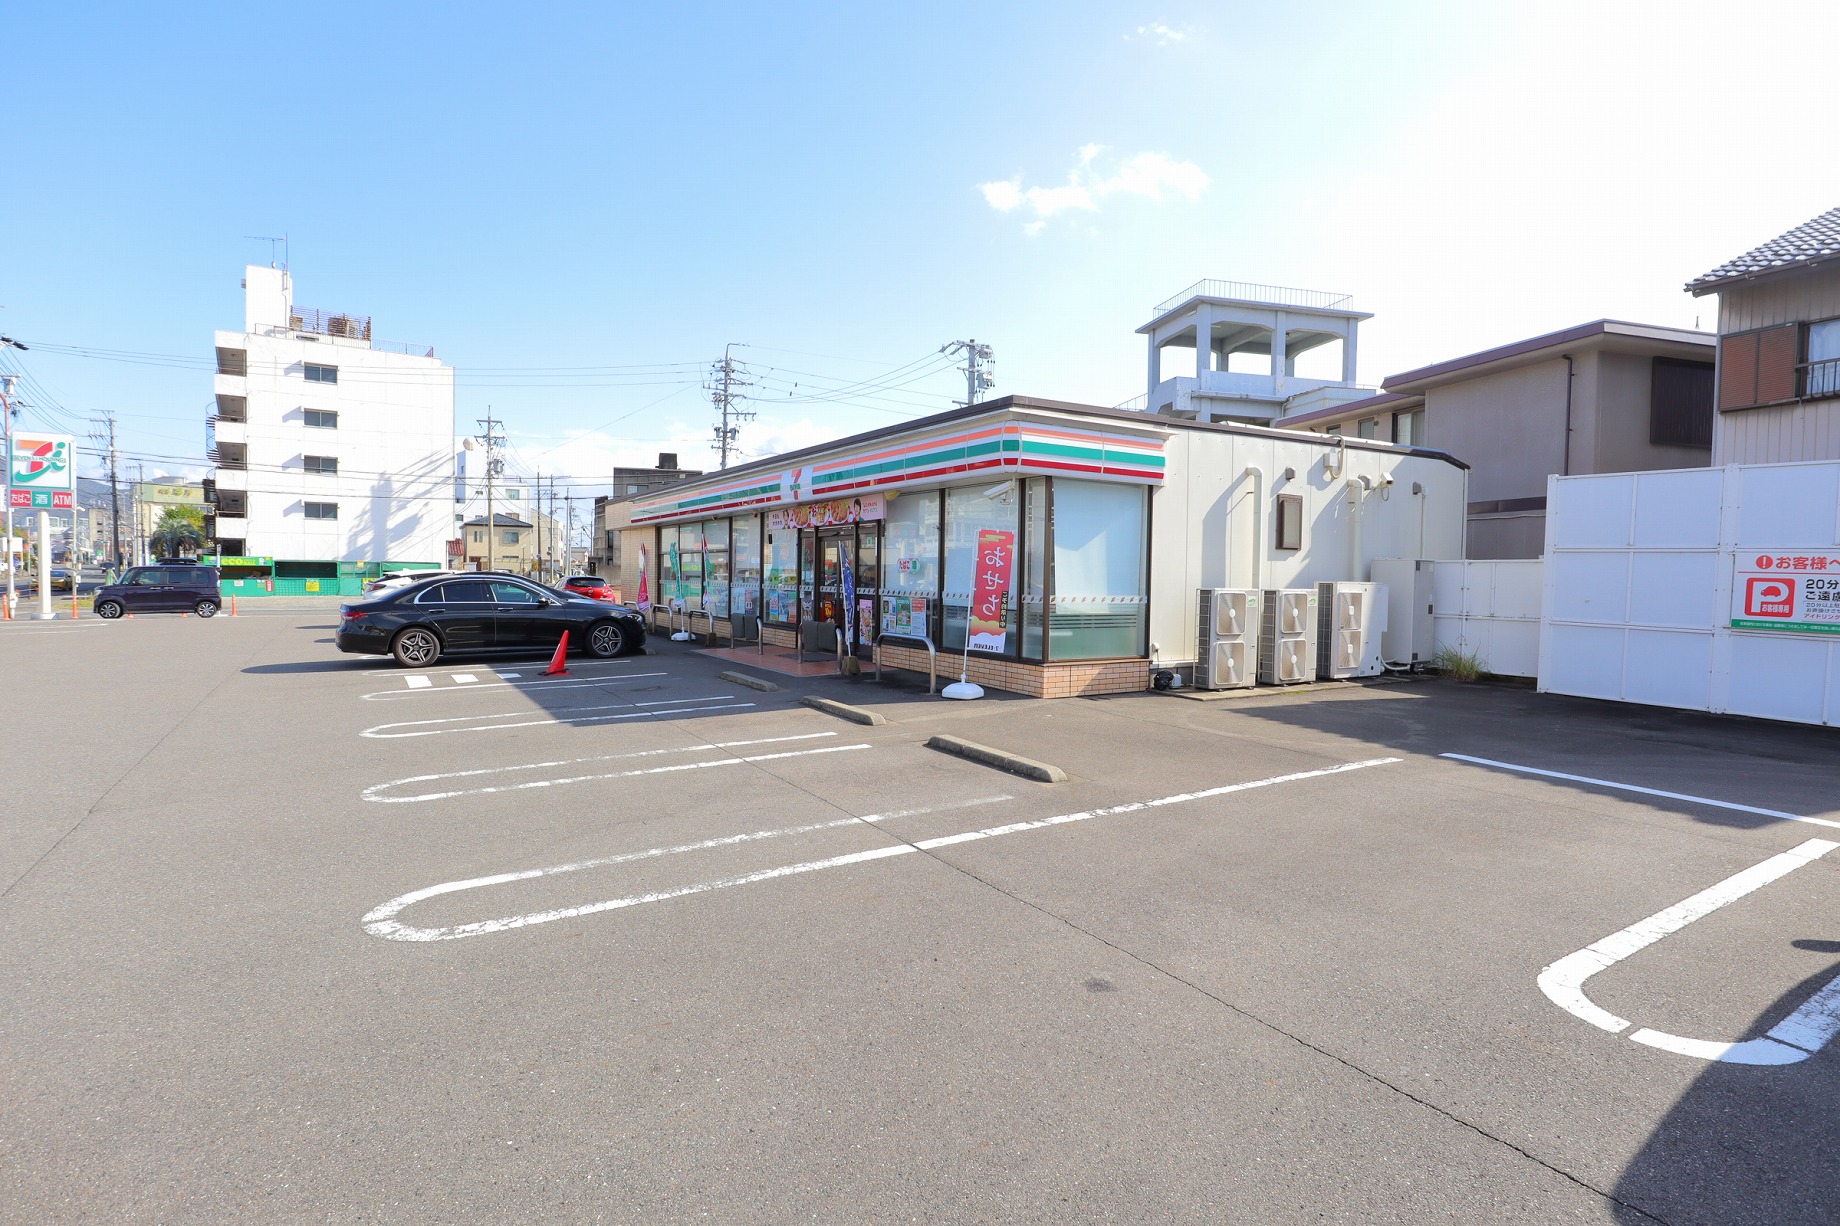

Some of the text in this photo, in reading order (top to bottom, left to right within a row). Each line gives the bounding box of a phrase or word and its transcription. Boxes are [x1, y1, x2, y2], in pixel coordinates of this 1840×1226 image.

[11, 494, 72, 505] たばこ 酒 ATM
[1775, 556, 1840, 570] お客様へ
[1806, 579, 1839, 590] 20分
